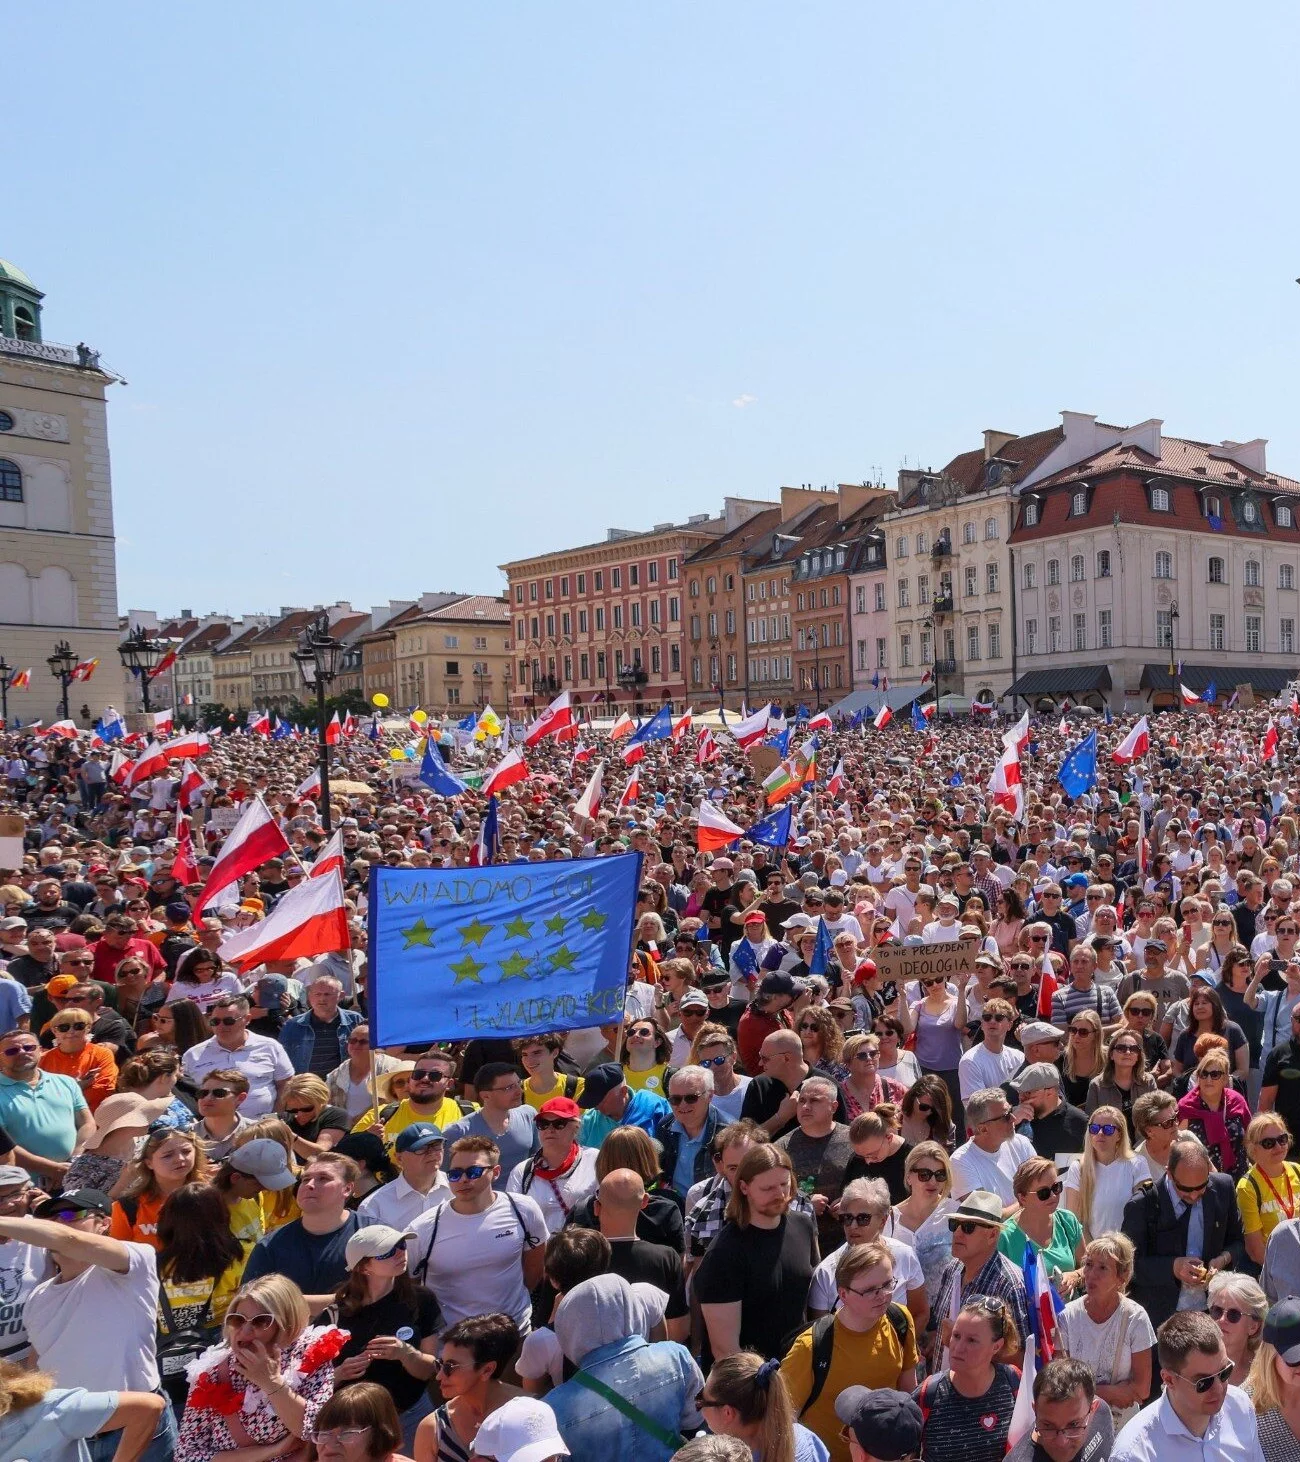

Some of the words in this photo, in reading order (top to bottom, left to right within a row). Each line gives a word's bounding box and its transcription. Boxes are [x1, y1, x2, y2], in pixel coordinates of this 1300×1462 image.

[384, 876, 533, 905] WIADOMO
[878, 950, 890, 958] TO
[893, 949, 907, 957] NIE
[911, 941, 972, 956] PREZYDENT
[880, 965, 891, 974] TO
[899, 958, 970, 976] IDEOLOGIA
